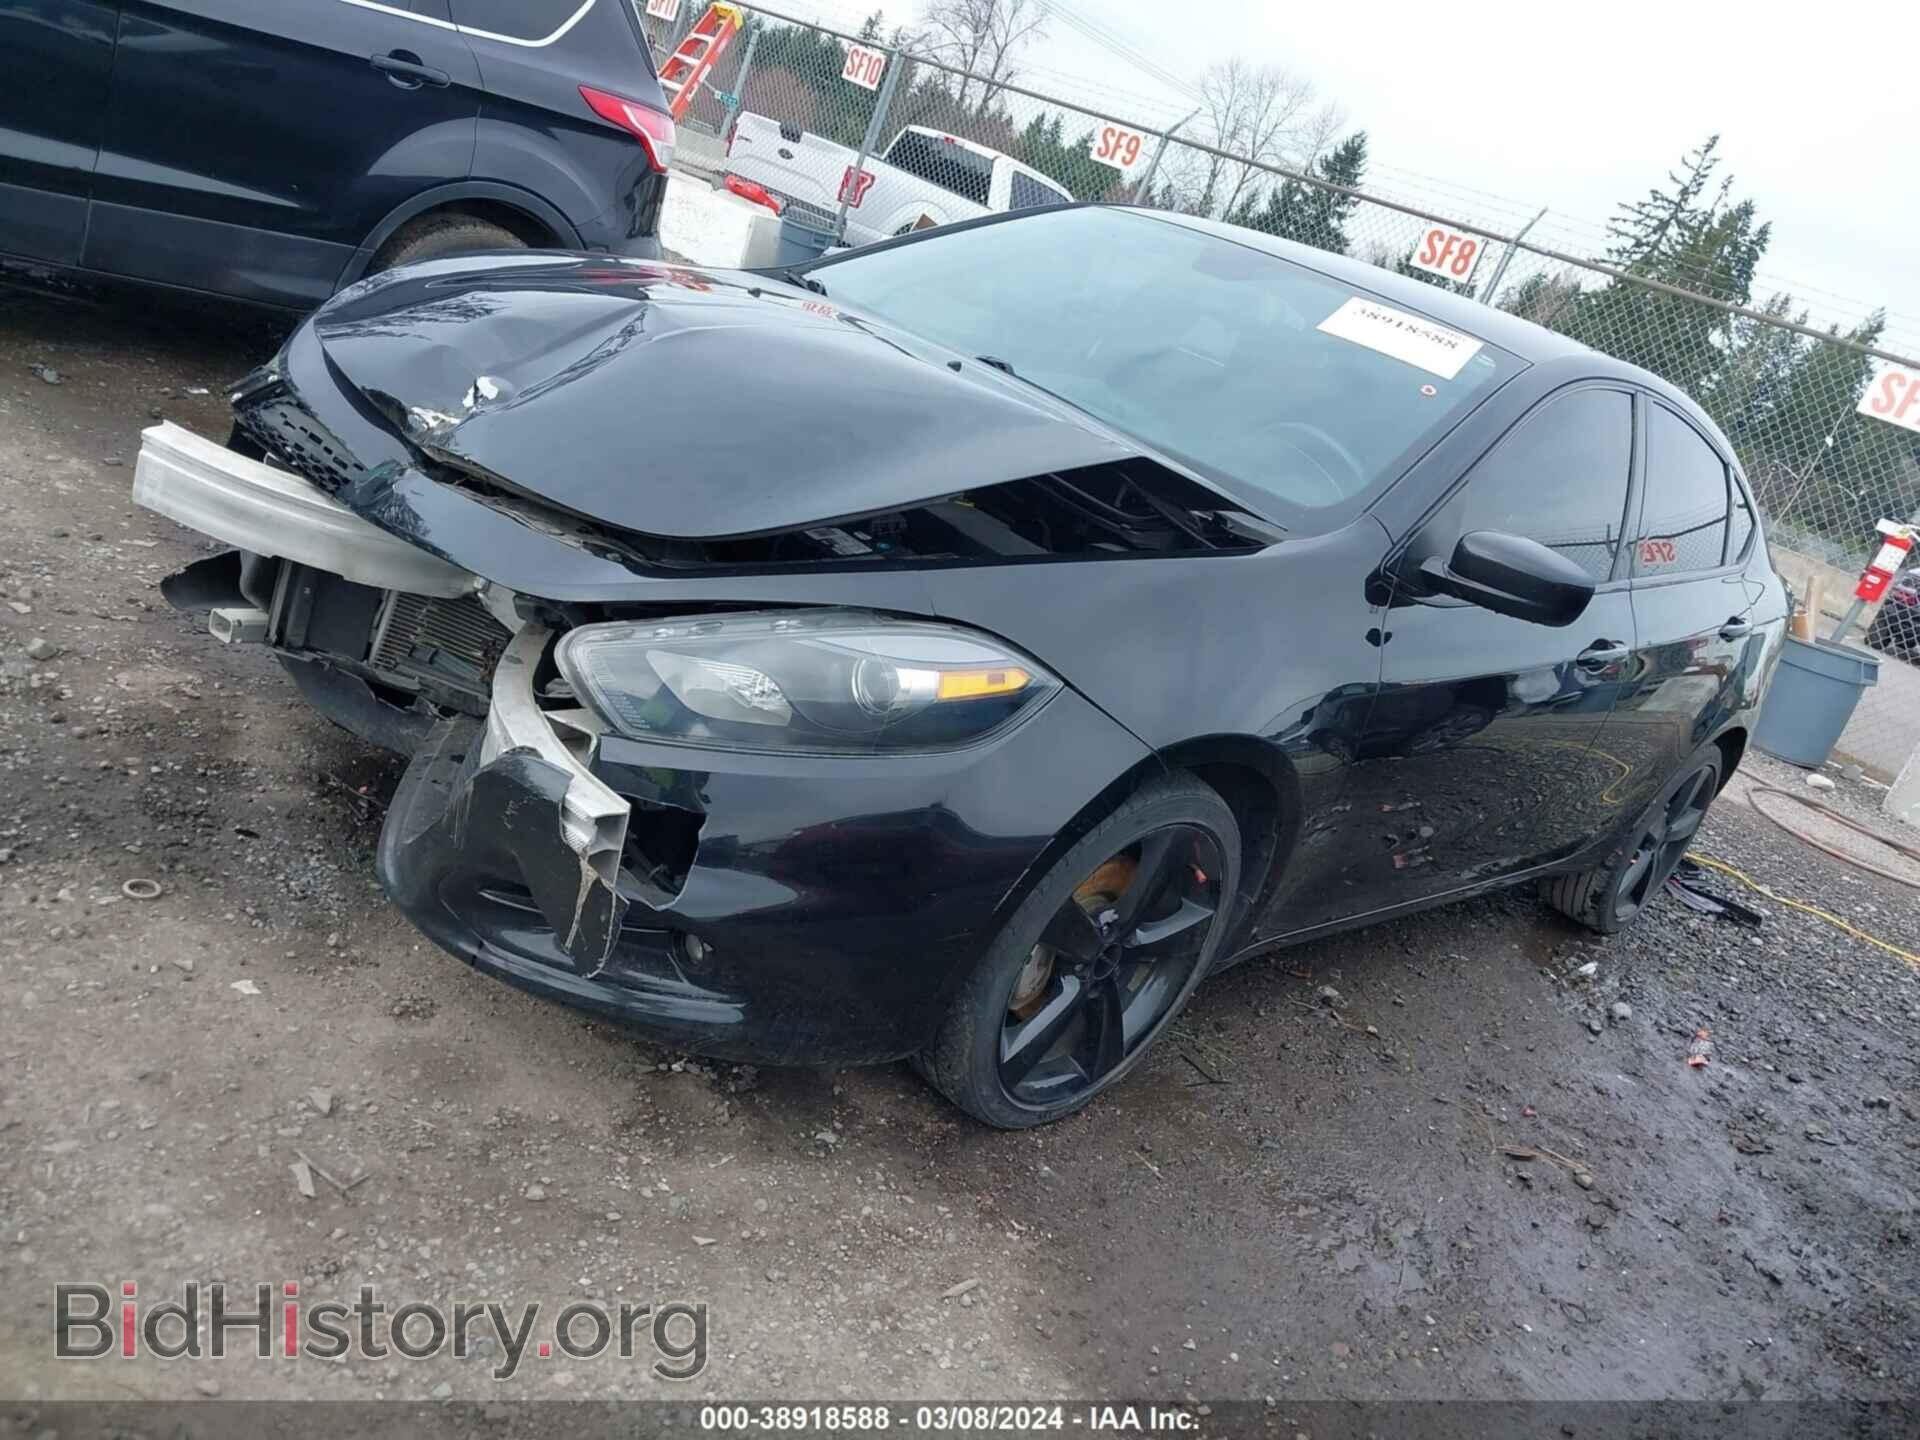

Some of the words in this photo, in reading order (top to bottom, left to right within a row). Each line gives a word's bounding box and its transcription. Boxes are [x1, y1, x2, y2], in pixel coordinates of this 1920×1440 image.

[846, 48, 883, 86] SF10
[1097, 126, 1141, 166] SF9
[1419, 229, 1477, 276] SF8
[1871, 372, 1920, 425] SF
